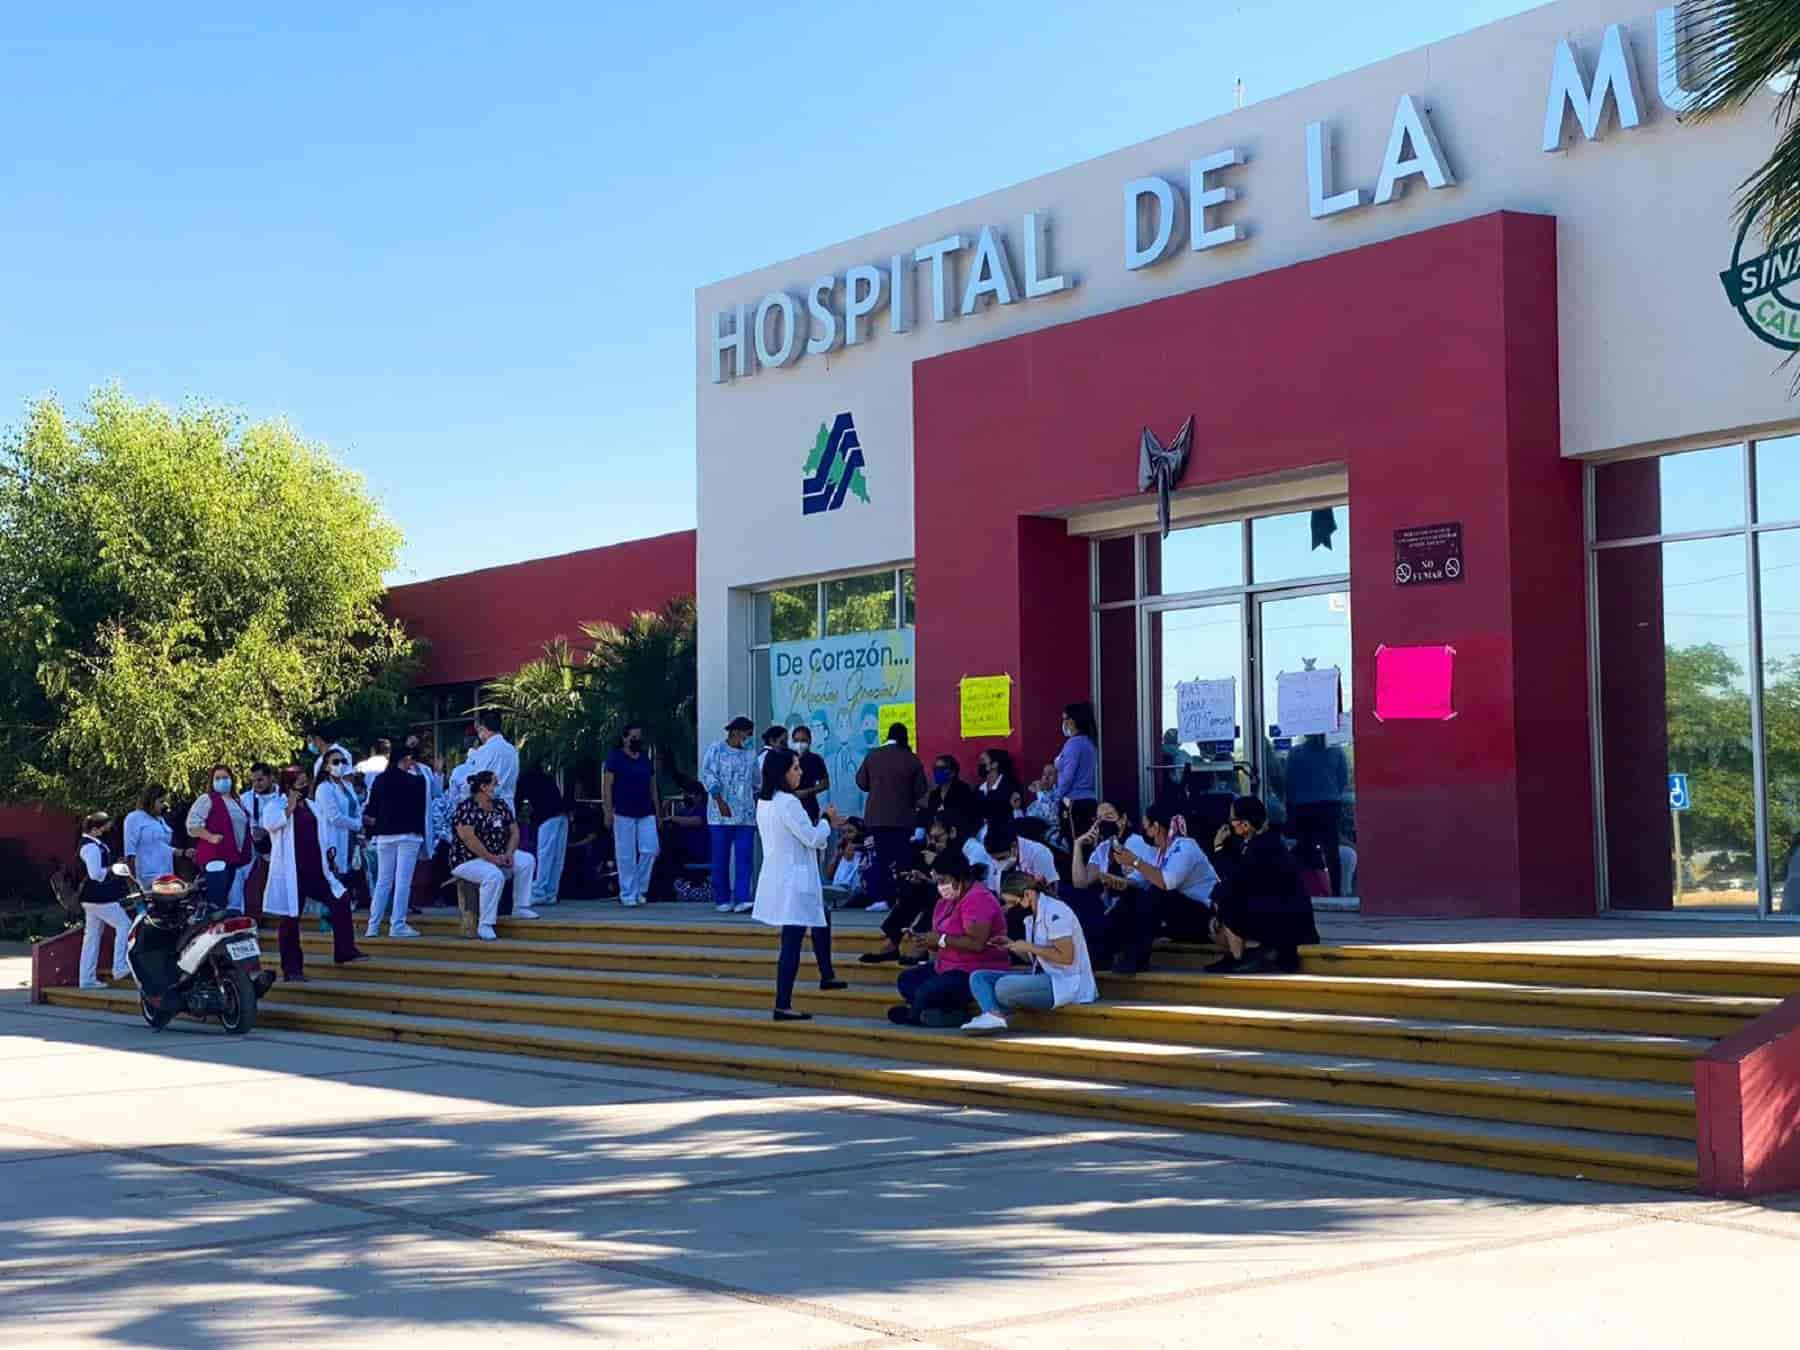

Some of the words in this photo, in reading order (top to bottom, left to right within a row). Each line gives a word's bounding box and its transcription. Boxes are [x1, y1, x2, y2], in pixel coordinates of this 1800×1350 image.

[711, 208, 1066, 384] HOSPITAL
[1123, 148, 1240, 271] DE
[1305, 92, 1452, 220] LA
[1543, 5, 1800, 152] MU
[776, 653, 803, 677] De
[809, 640, 909, 672] Corazón...
